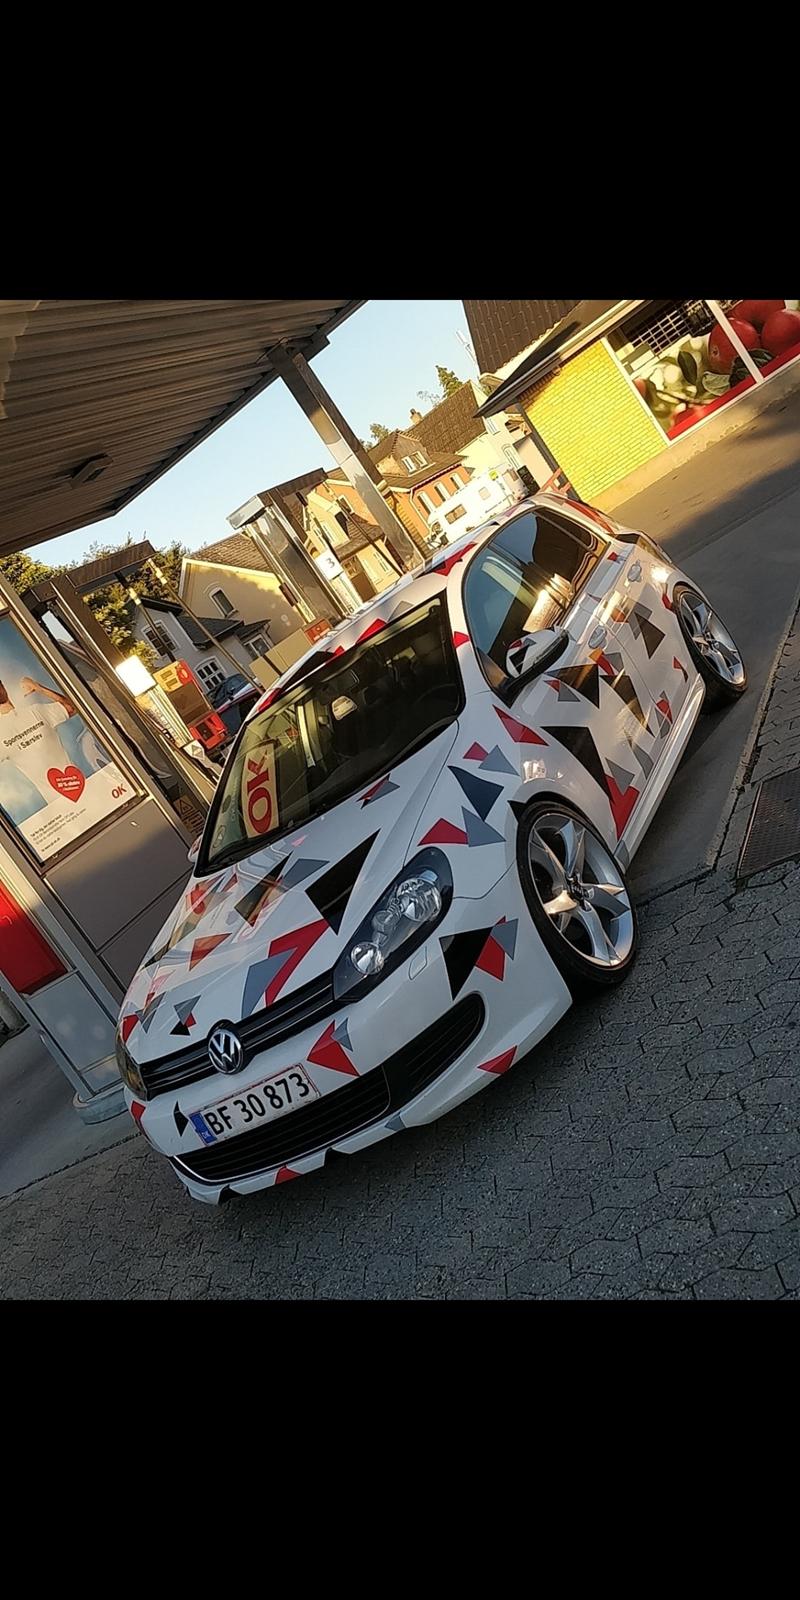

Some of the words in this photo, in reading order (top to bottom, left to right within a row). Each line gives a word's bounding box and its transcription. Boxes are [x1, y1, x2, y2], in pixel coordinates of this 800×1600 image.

[325, 557, 335, 568] 3
[3, 721, 44, 746] Sportsvennerne
[112, 783, 127, 798] OK
[247, 749, 272, 833] OK
[204, 1105, 232, 1135] BF
[233, 1093, 266, 1123] 30
[263, 1072, 310, 1109] 873
